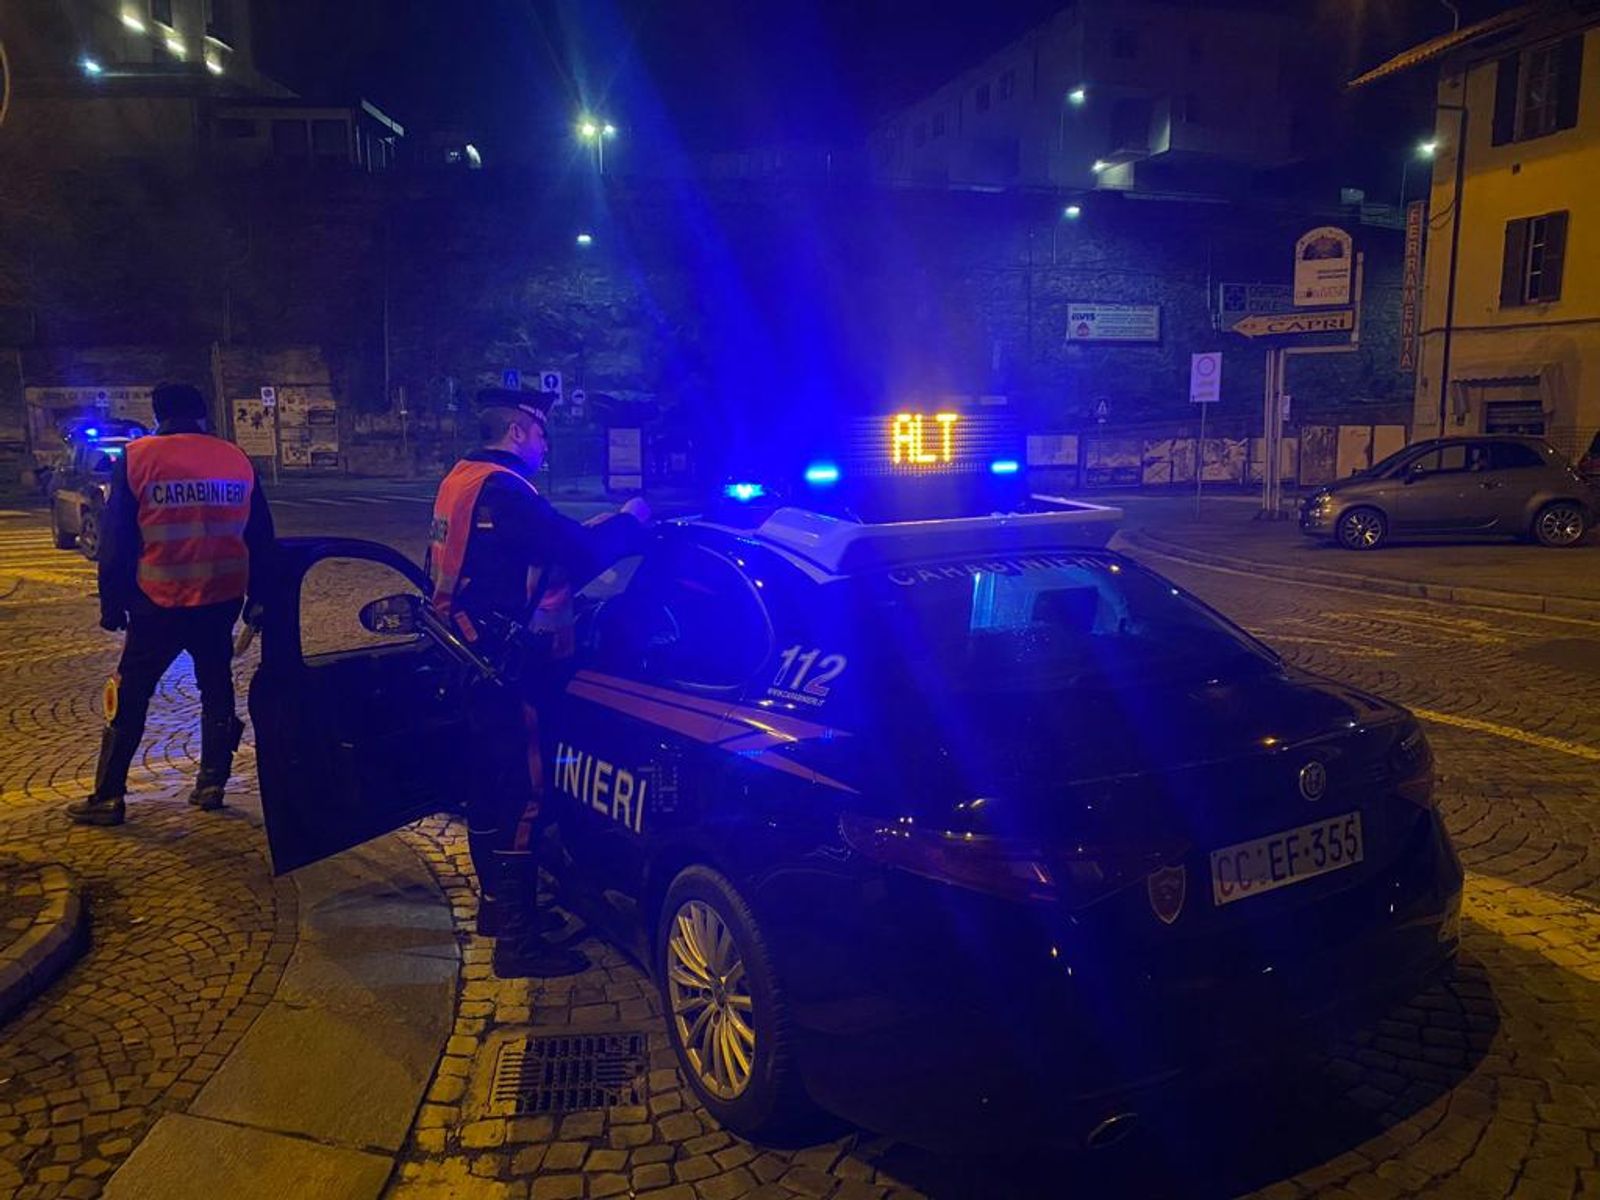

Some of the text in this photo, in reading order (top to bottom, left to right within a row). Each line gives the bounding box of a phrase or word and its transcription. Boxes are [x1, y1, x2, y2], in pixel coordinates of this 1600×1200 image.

[1400, 209, 1421, 369] FERRAMENTA
[1267, 318, 1345, 333] CAPRI
[893, 413, 958, 463] ALT
[152, 482, 246, 504] CARABINIERI
[772, 644, 848, 697] 112
[553, 741, 647, 835] INIERI
